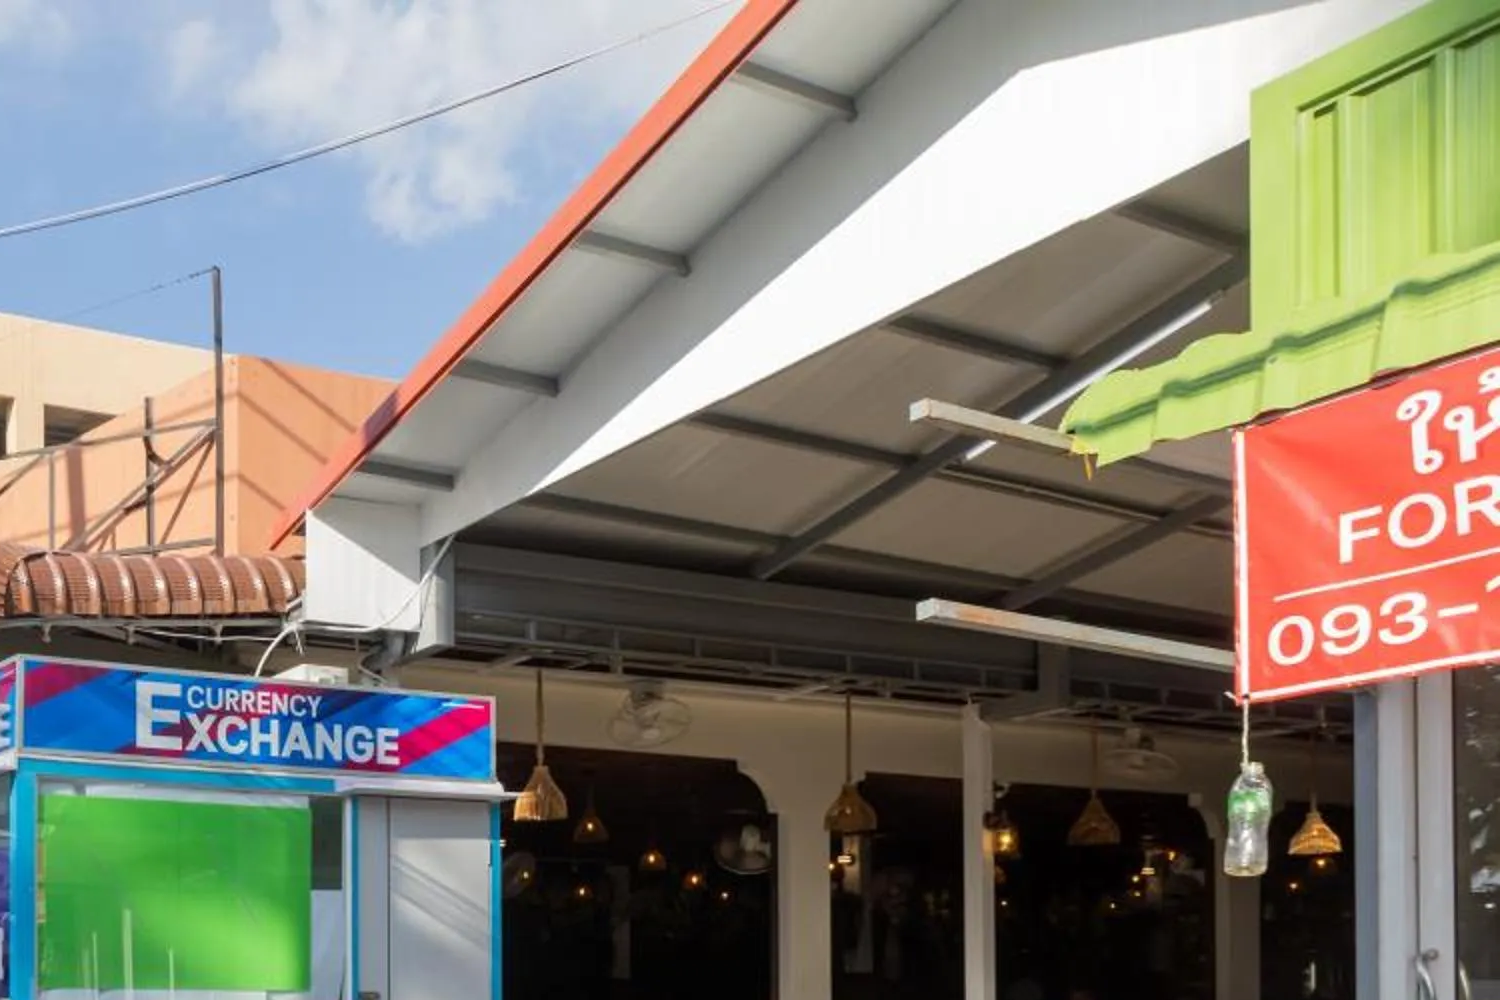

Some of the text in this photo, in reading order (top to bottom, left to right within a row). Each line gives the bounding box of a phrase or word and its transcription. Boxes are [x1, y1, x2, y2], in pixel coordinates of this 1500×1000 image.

[1339, 474, 1500, 564] FOR
[135, 680, 400, 765] EXCHANGE
[187, 685, 322, 718] CURRENCY
